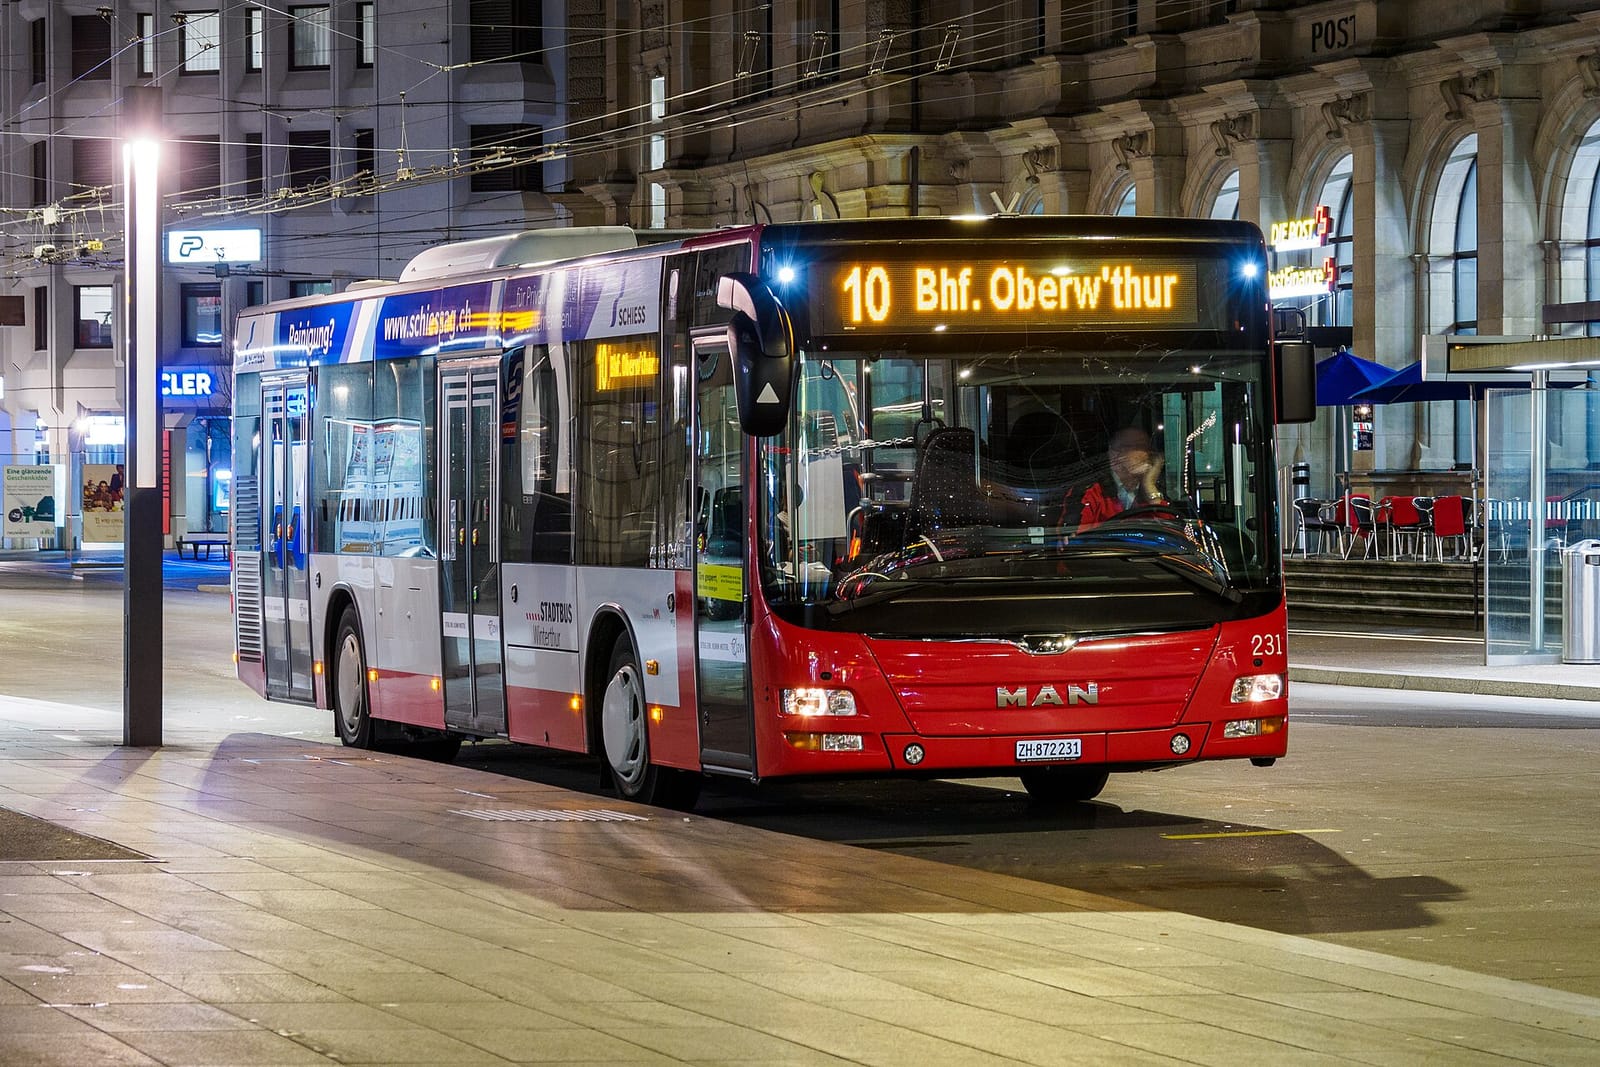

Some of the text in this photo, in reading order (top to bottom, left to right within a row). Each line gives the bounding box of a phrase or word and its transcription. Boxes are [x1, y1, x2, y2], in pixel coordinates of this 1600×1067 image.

[1311, 14, 1356, 53] POST
[1289, 217, 1317, 243] POST
[843, 264, 1177, 322] 10 Bhf. Oberw'thur
[618, 305, 646, 326] SCHIESS
[288, 317, 336, 356] Reinigung?
[540, 601, 573, 624] STADTBUS
[1251, 633, 1283, 656] 231
[996, 682, 1099, 708] MAN
